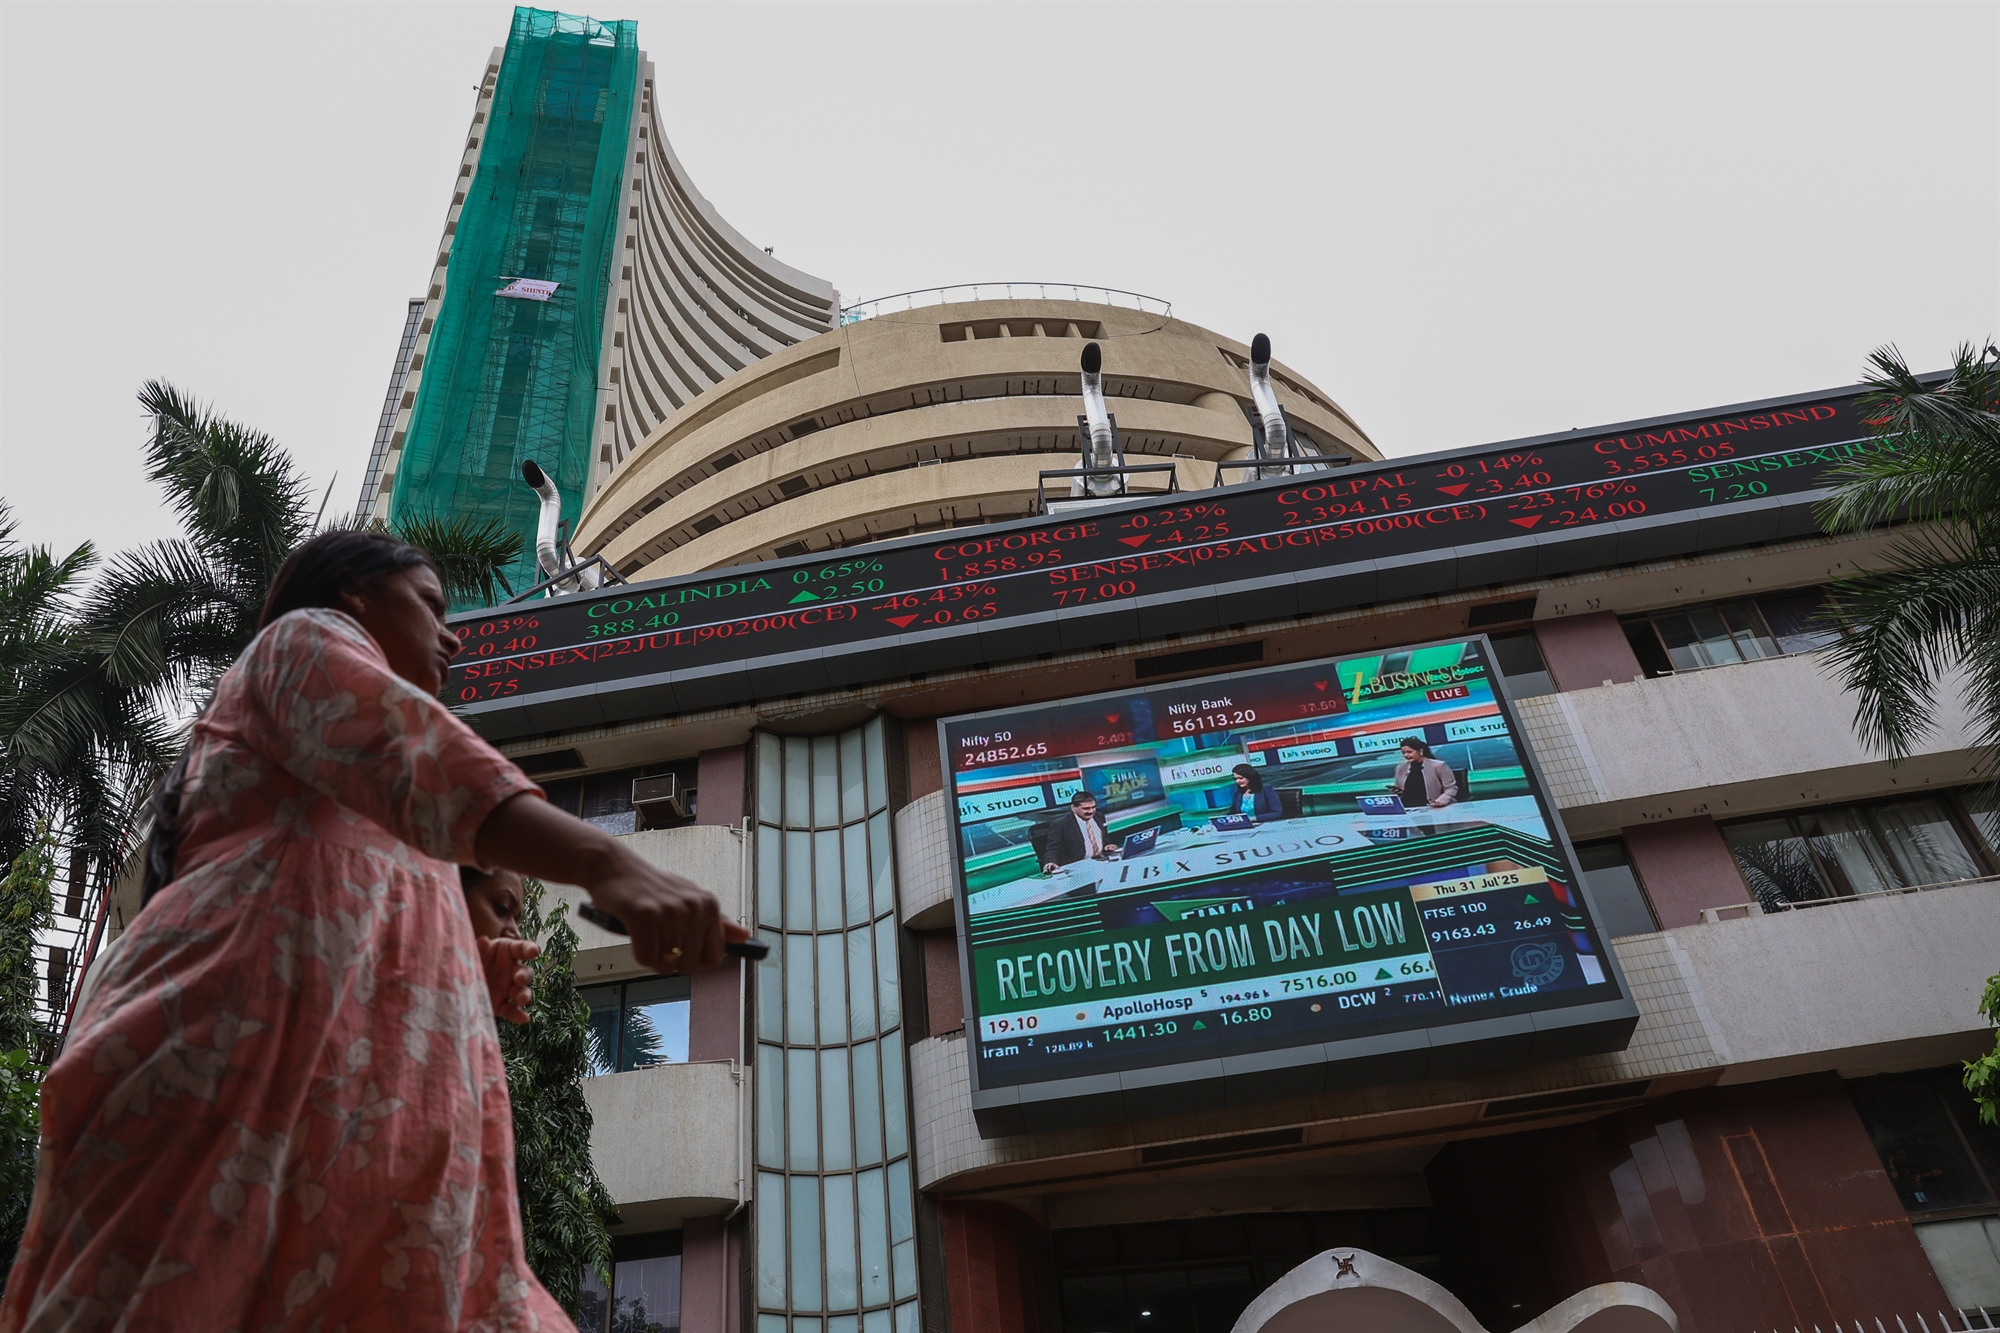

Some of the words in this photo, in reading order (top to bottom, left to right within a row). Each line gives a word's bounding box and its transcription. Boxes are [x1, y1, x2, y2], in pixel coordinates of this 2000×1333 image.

[1593, 405, 1838, 455] CUMMINSIND
[1436, 451, 1544, 478] -0.14%
[1604, 441, 1735, 474] 3,535.05
[1276, 472, 1417, 506] COLPAL
[1475, 471, 1552, 494] -3.40
[1507, 479, 1637, 511] -23.76%
[1699, 481, 1769, 502] 7.20
[1119, 502, 1227, 530] -0.23%
[1284, 492, 1413, 529] 2,394.15
[1549, 499, 1647, 526] -24.00
[933, 523, 1100, 561] COFORGE
[1049, 503, 1487, 586] SENSEX|05AUG|85000(CE)
[1156, 521, 1231, 544] -4.25
[792, 559, 884, 584] 0.65%
[940, 548, 1063, 582] 1,858.95
[587, 577, 773, 619] COALINDIA
[822, 578, 885, 601] 2.50
[872, 581, 997, 611] -46.43%
[1052, 580, 1137, 606] 77.00
[585, 611, 680, 639] 388.40
[922, 601, 998, 625] -0.65
[464, 604, 858, 680] SENSEX|22JUL|90200(CE)
[468, 635, 538, 657] -0.40
[460, 679, 519, 701] 0.75
[1432, 688, 1463, 700] LIVE
[1168, 703, 1197, 716] Nifty
[1201, 696, 1233, 710] Bank
[1172, 709, 1257, 734] 56113.20
[961, 735, 990, 747] Nifty
[994, 731, 1012, 743] 50
[1301, 747, 1332, 757] STUDIO
[964, 742, 1048, 766] 24852.65
[1191, 765, 1223, 777] STUDIO
[987, 795, 1040, 812] STUDIO
[1214, 835, 1345, 866] STUDIO
[1433, 885, 1456, 896] Thu
[1460, 881, 1476, 892] 31
[1481, 873, 1519, 889] Jul'25
[1423, 906, 1456, 920] FTSE
[1460, 902, 1487, 915] 100
[1431, 923, 1496, 943] 9163.43
[1513, 916, 1552, 930] 26.49
[996, 938, 1151, 1001] RECOVERY
[1165, 924, 1256, 978] FROM
[1263, 913, 1324, 963] DAY
[1334, 902, 1406, 953] LOW
[988, 1016, 1038, 1034] 19.10
[1103, 996, 1194, 1020] ApolloHosp
[1200, 989, 1208, 998] 5
[1280, 970, 1358, 993] 7516.00
[1027, 1038, 1034, 1047] 2
[1102, 1021, 1178, 1042] 1441.30
[1220, 1006, 1272, 1026] 16.80
[1338, 991, 1377, 1009] DCW
[1384, 987, 1391, 996] 2
